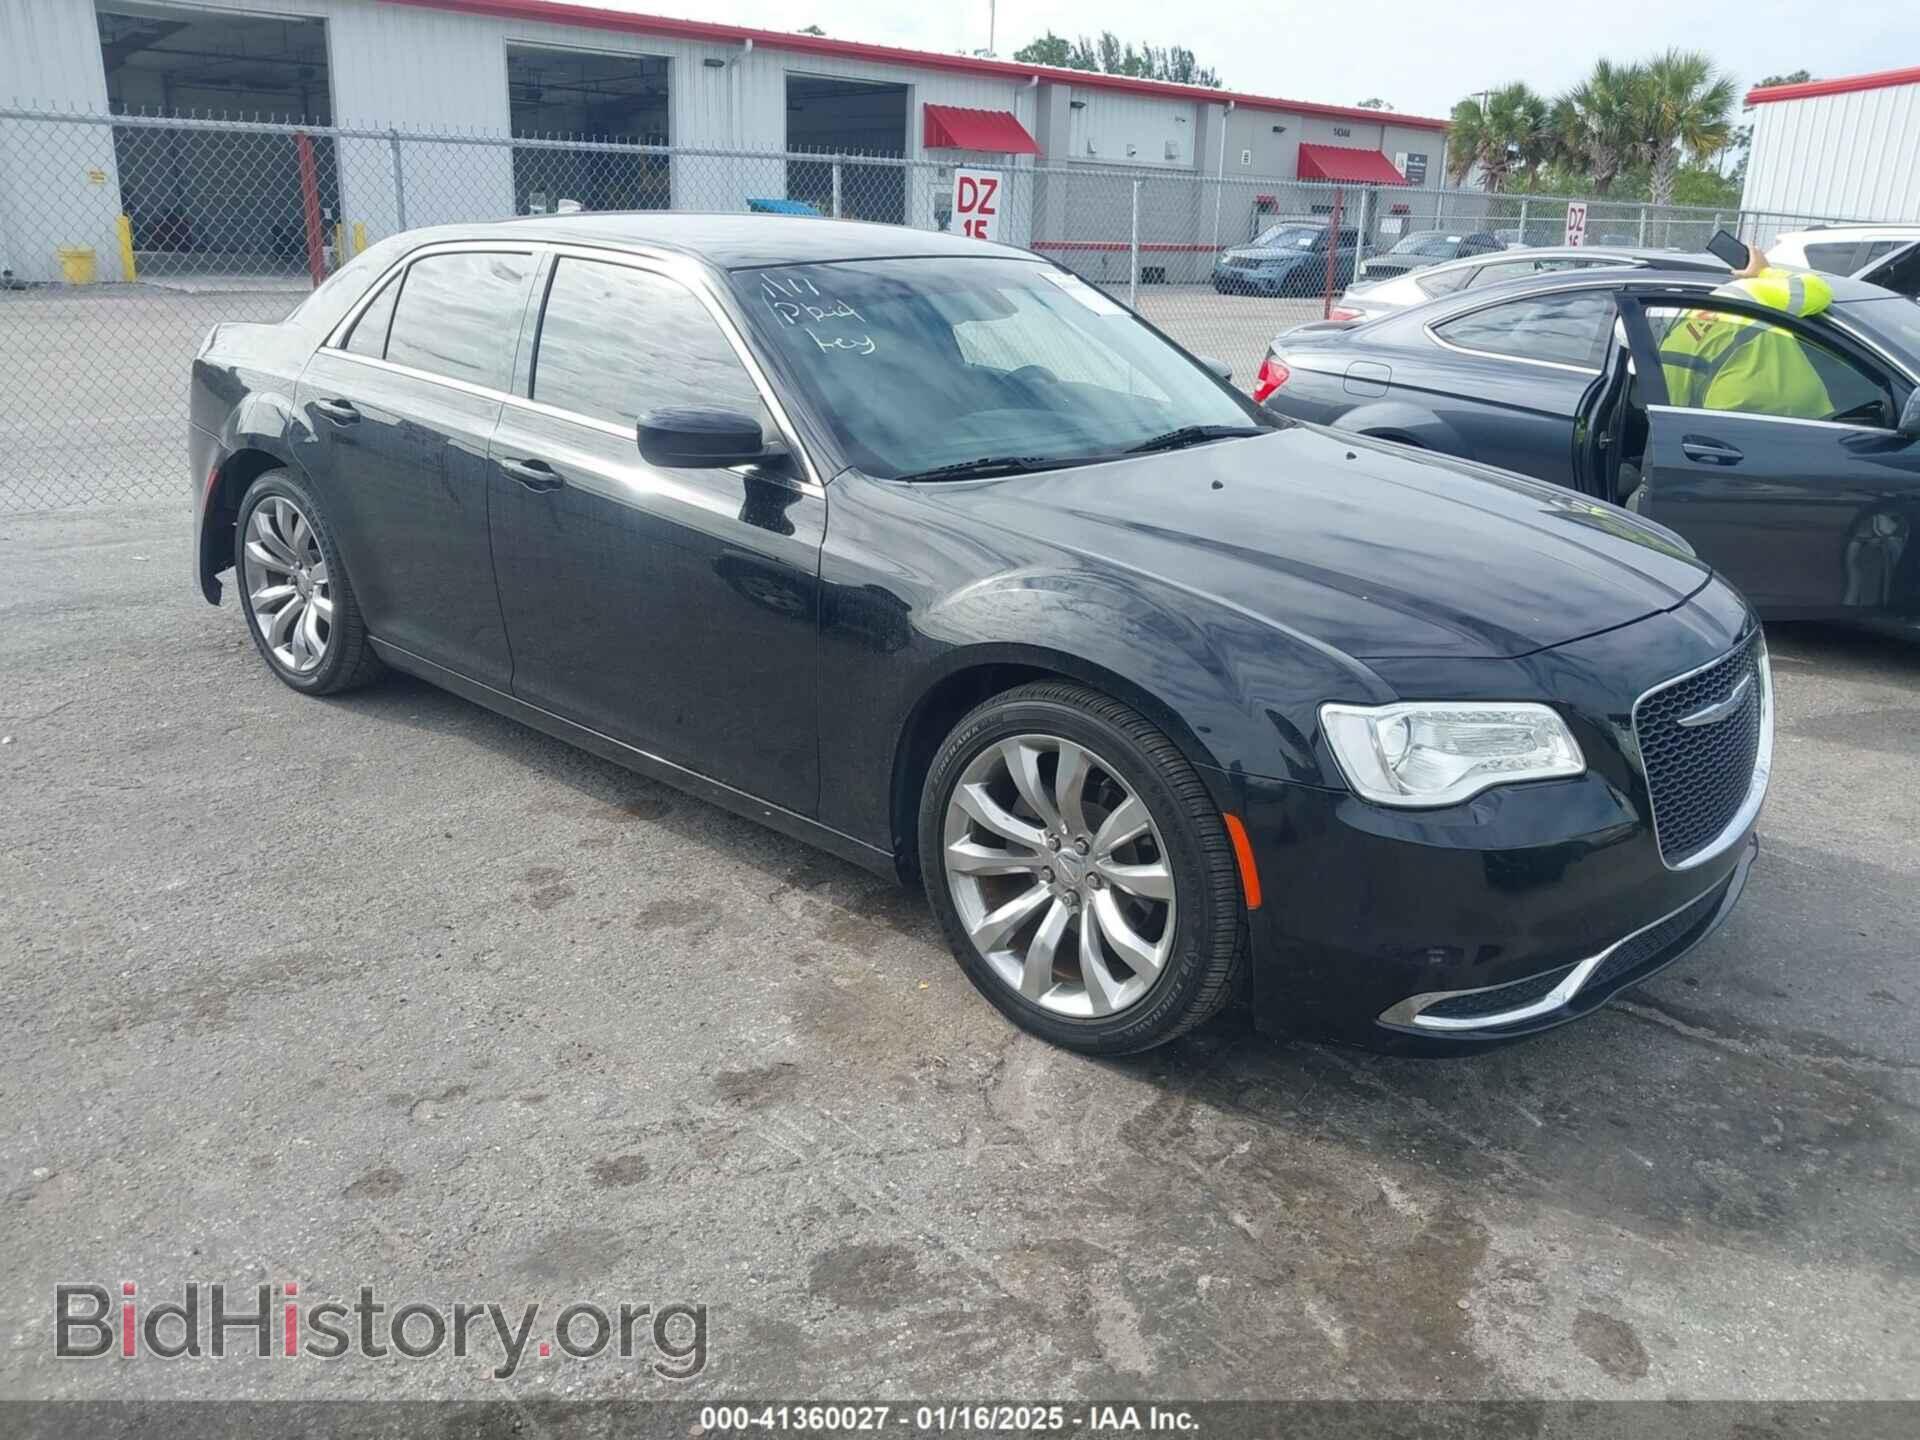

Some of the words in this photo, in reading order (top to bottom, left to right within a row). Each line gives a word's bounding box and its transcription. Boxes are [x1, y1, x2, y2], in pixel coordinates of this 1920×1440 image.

[958, 176, 998, 215] DZ
[963, 219, 987, 240] 15
[1568, 207, 1585, 231] DZ
